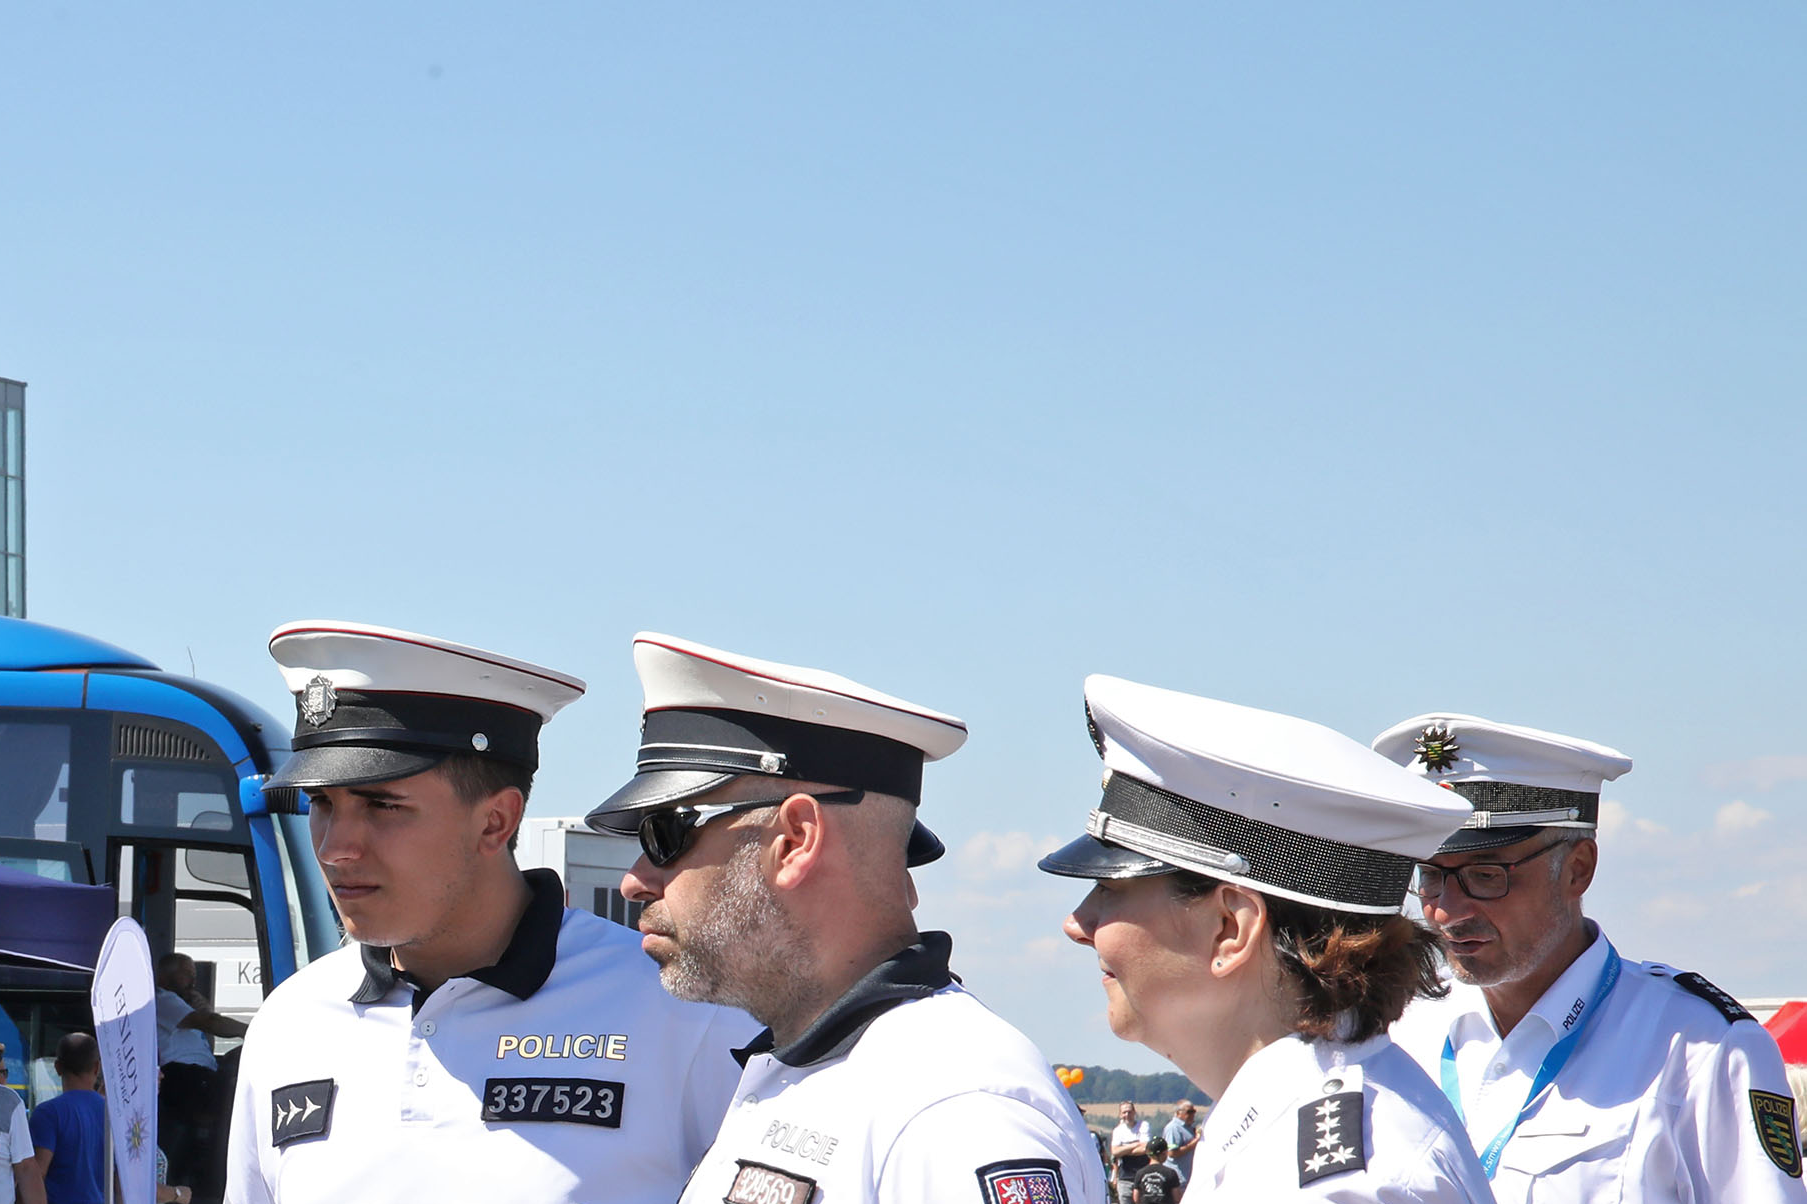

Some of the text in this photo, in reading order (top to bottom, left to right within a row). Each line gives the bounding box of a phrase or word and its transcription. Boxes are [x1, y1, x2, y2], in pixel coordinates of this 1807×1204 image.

[1562, 997, 1586, 1031] POLIZEI
[496, 1034, 628, 1061] POLICIE
[488, 1084, 615, 1119] 337523
[760, 1119, 839, 1166] POLICIE
[1222, 1106, 1260, 1152] POLIZEI
